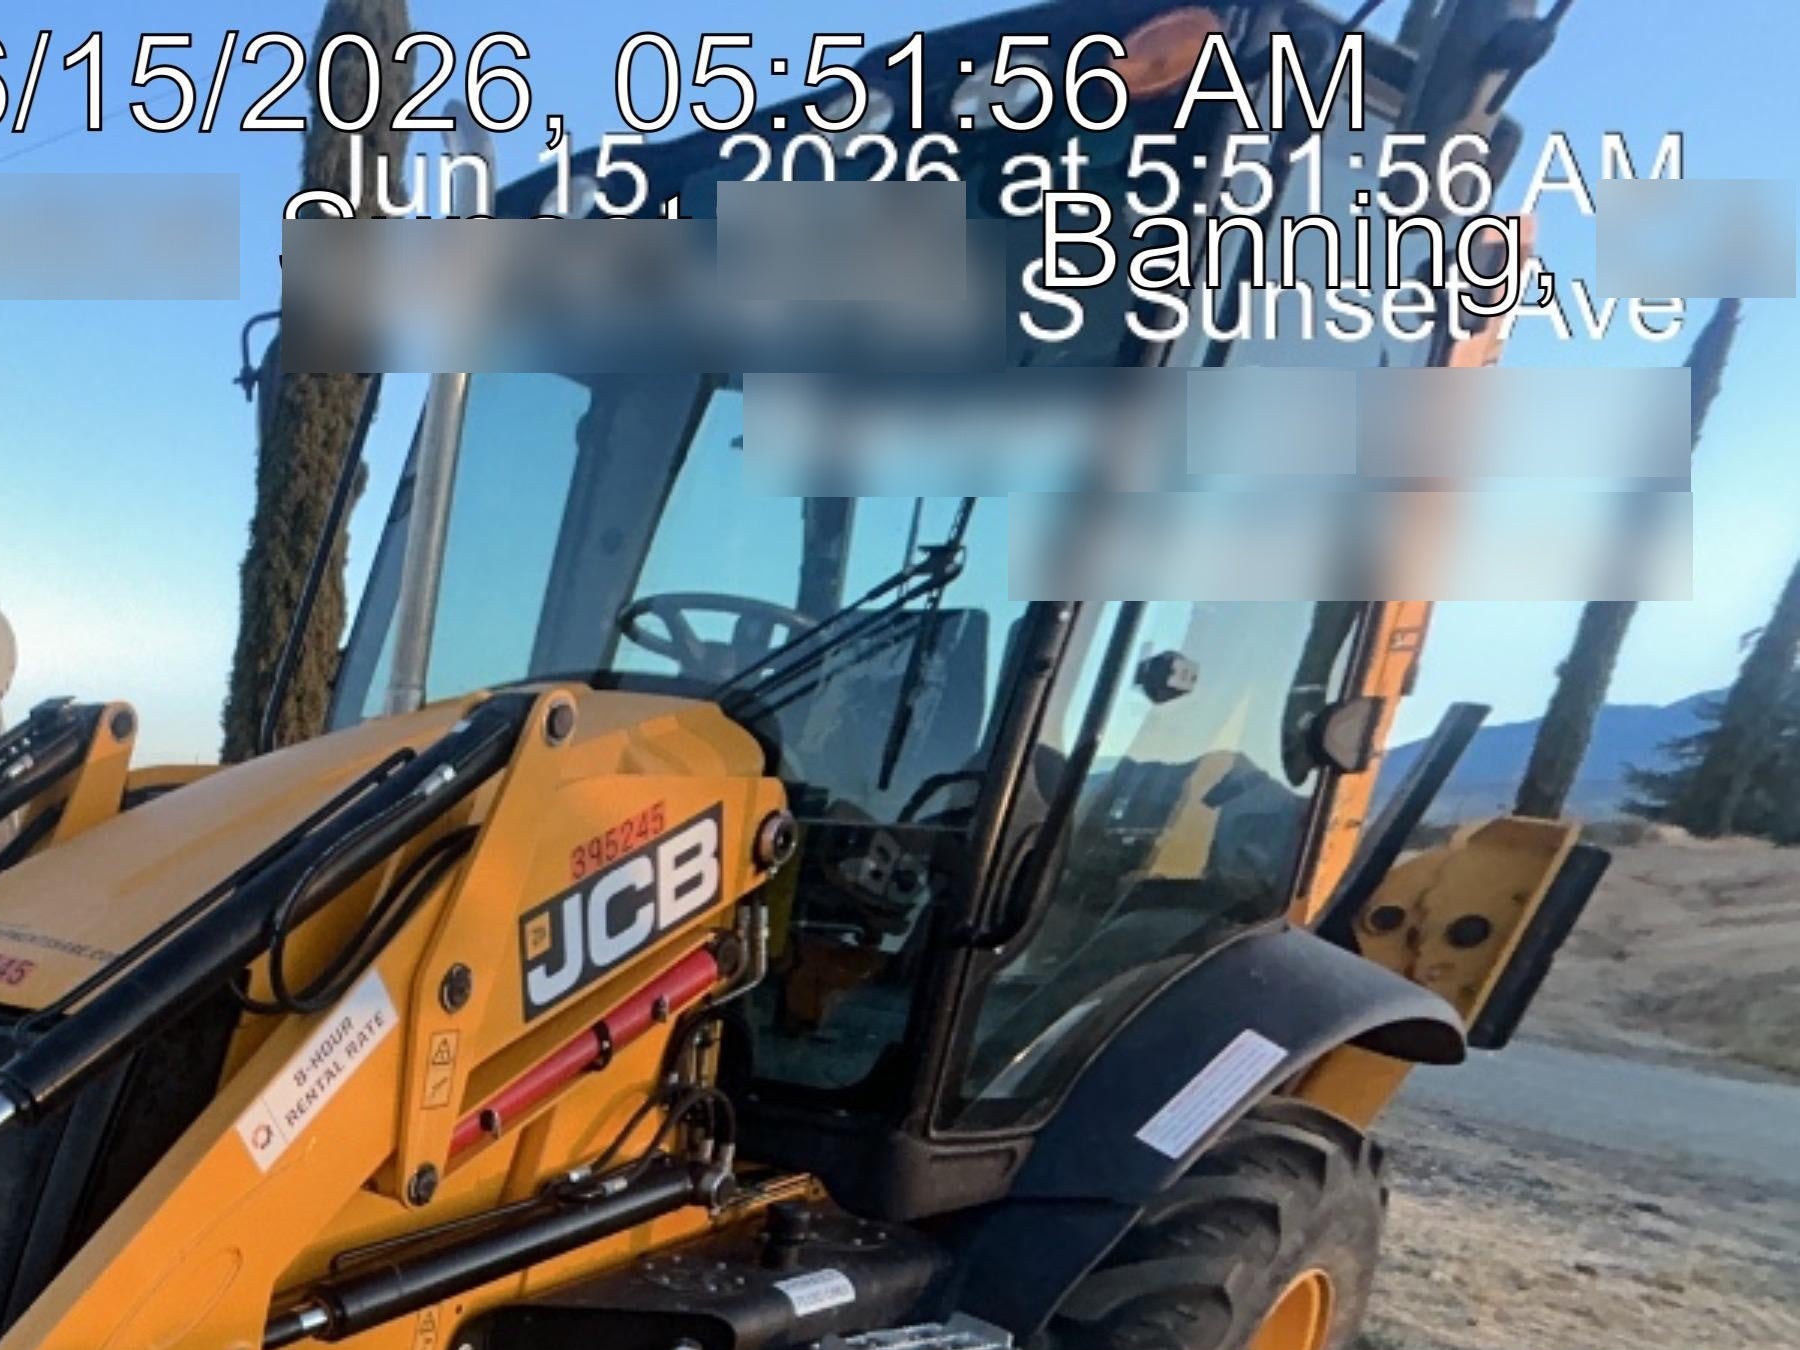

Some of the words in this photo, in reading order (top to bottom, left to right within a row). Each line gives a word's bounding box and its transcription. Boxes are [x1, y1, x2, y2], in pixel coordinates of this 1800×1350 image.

[570, 801, 665, 880] 395245
[527, 817, 720, 1006] JCB
[284, 1060, 345, 1128] RENTAL
[345, 1010, 385, 1060] RATE
